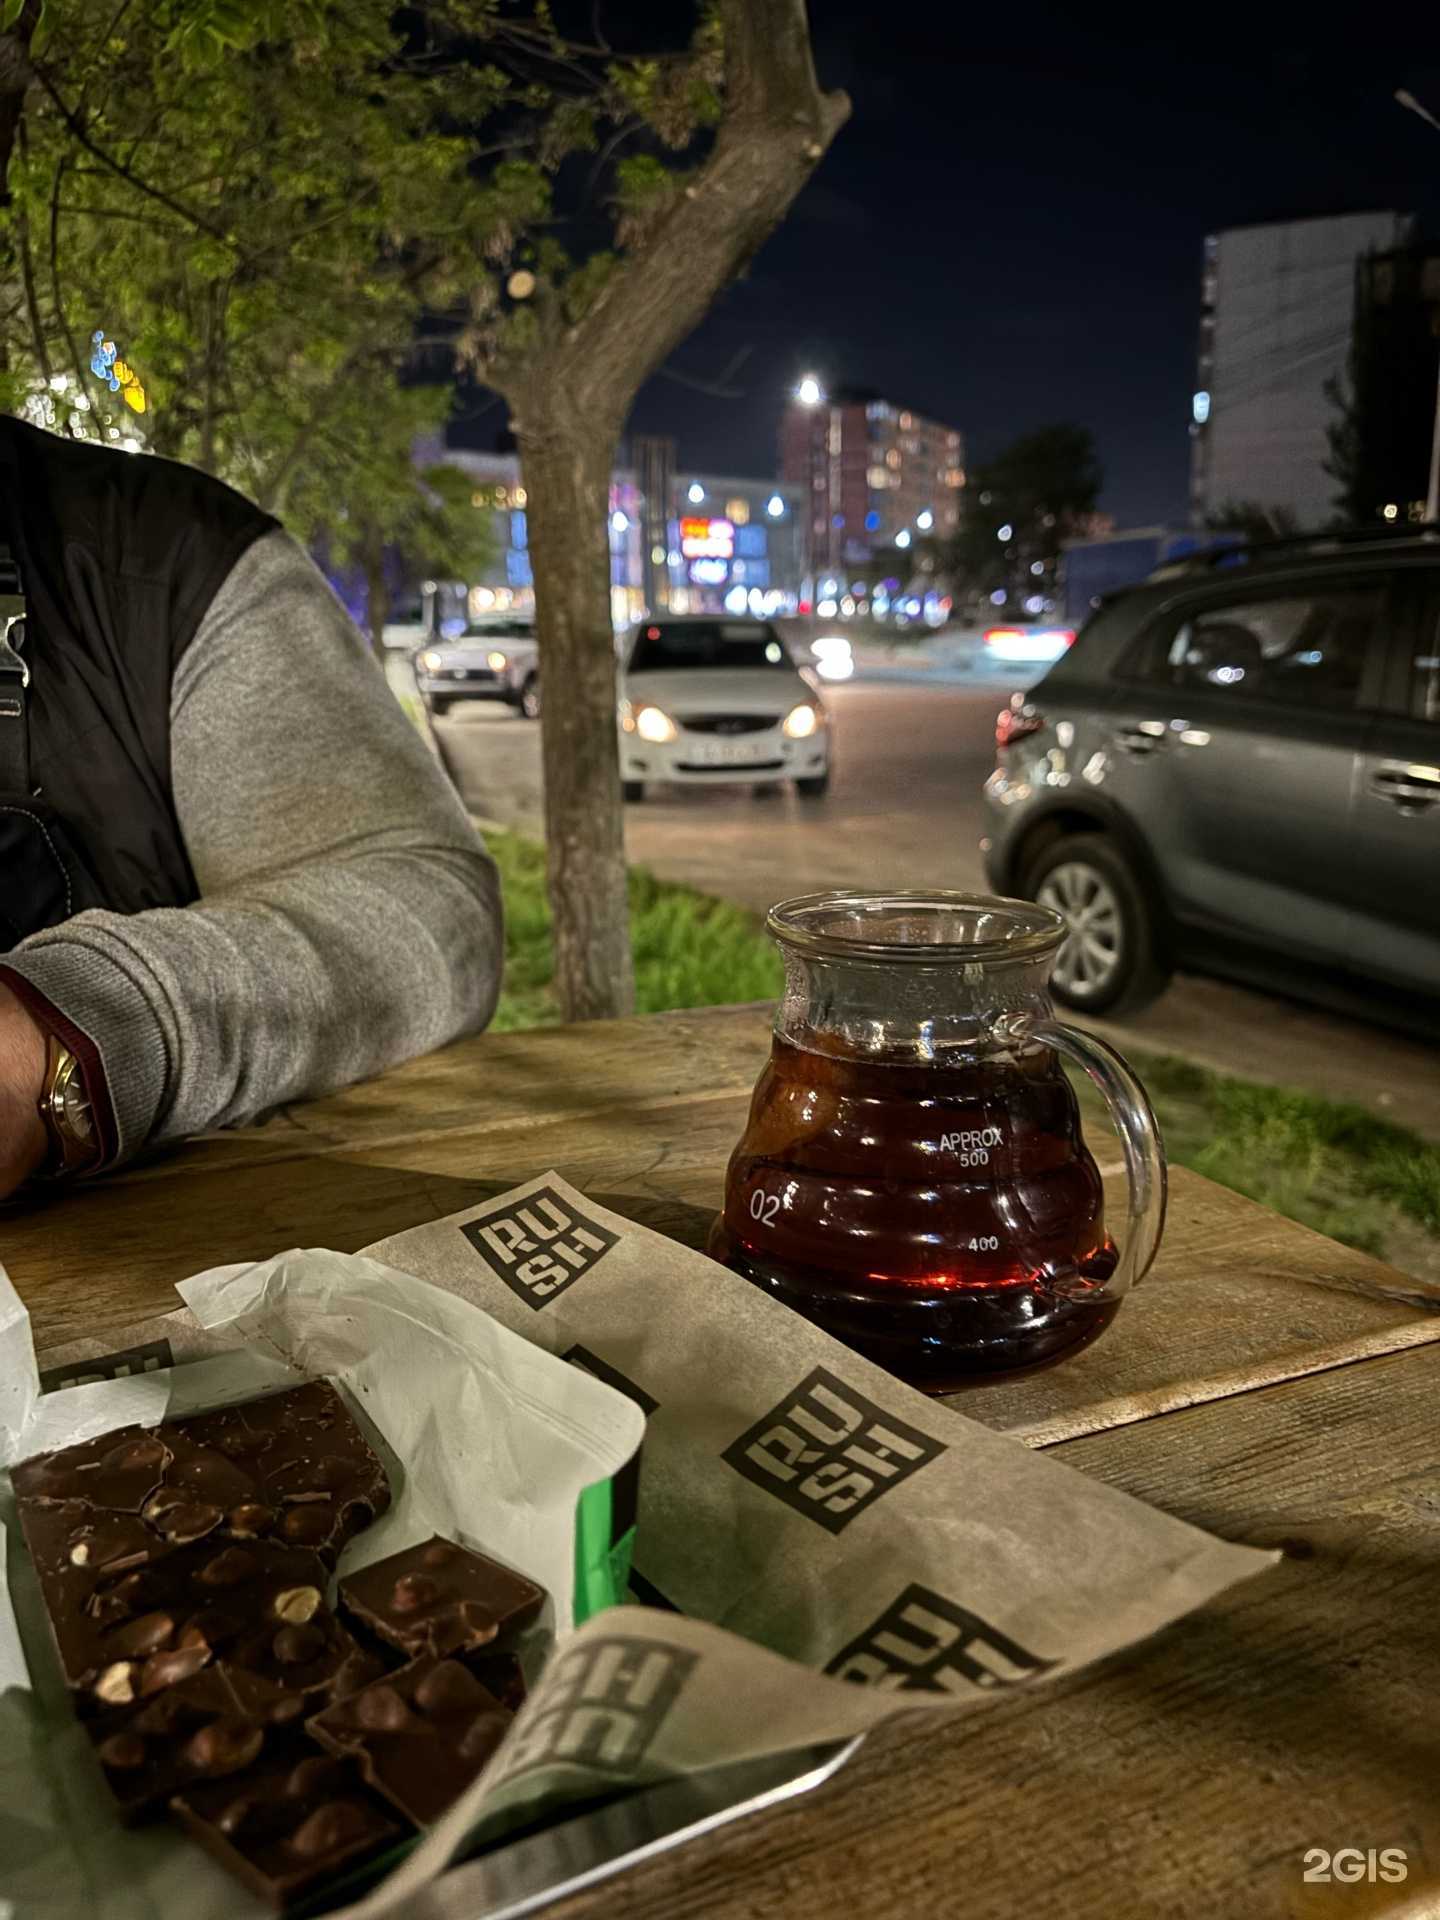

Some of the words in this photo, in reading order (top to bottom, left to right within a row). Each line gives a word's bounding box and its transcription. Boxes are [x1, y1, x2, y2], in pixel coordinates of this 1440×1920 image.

[940, 1127, 1003, 1152] APPROX
[960, 1151, 989, 1168] 500
[750, 1188, 780, 1228] 02
[968, 1235, 999, 1252] 400
